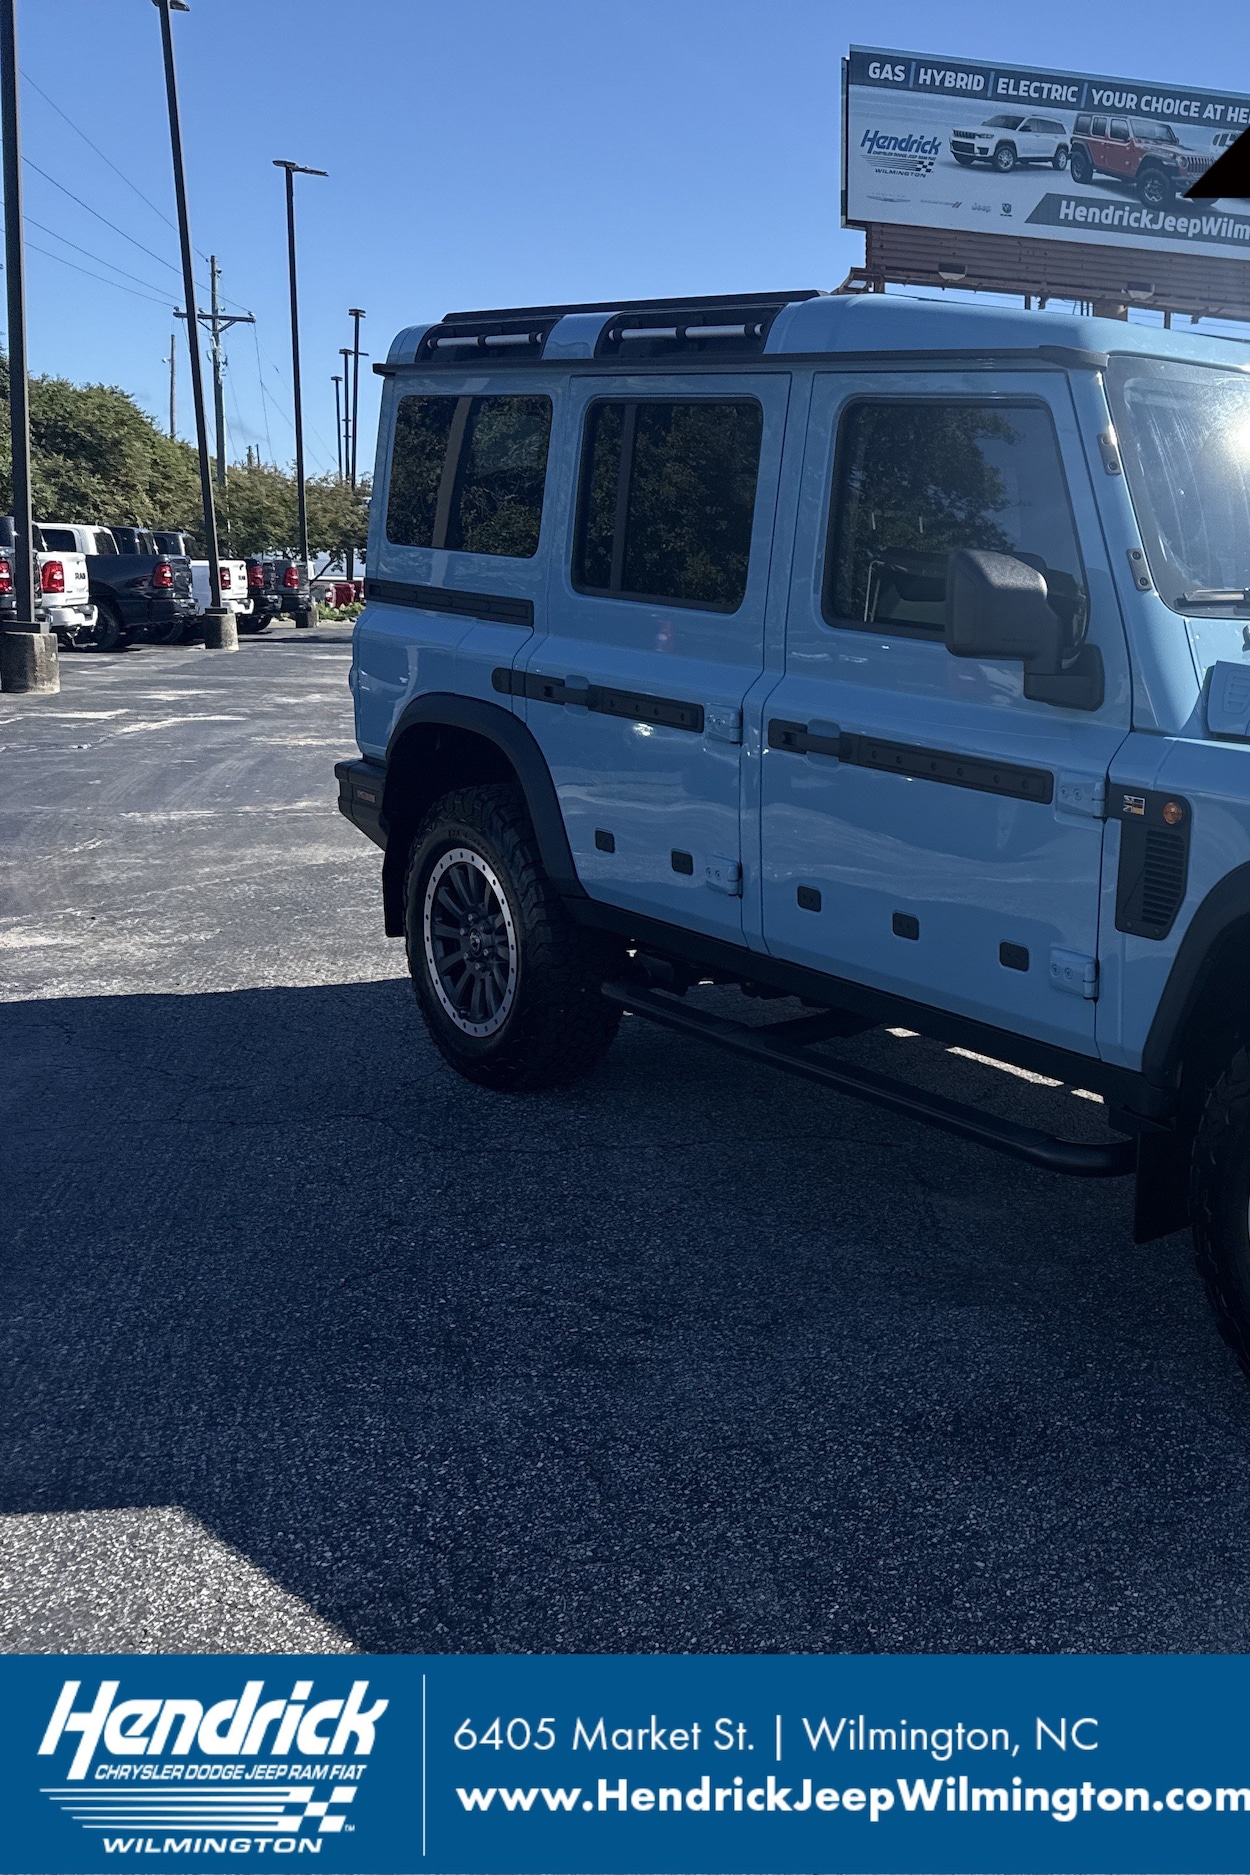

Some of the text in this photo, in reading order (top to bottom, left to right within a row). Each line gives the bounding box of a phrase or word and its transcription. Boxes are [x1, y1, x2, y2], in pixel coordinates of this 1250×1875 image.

[868, 61, 906, 82] GAS
[918, 67, 985, 92] HYBRID
[996, 77, 1079, 103] ELECTRIC
[1091, 88, 1137, 110] YOUR
[1140, 95, 1201, 118] CHOICE
[1202, 103, 1226, 121] AT
[860, 129, 942, 155] Hendrick
[875, 168, 926, 178] WILMINGTON
